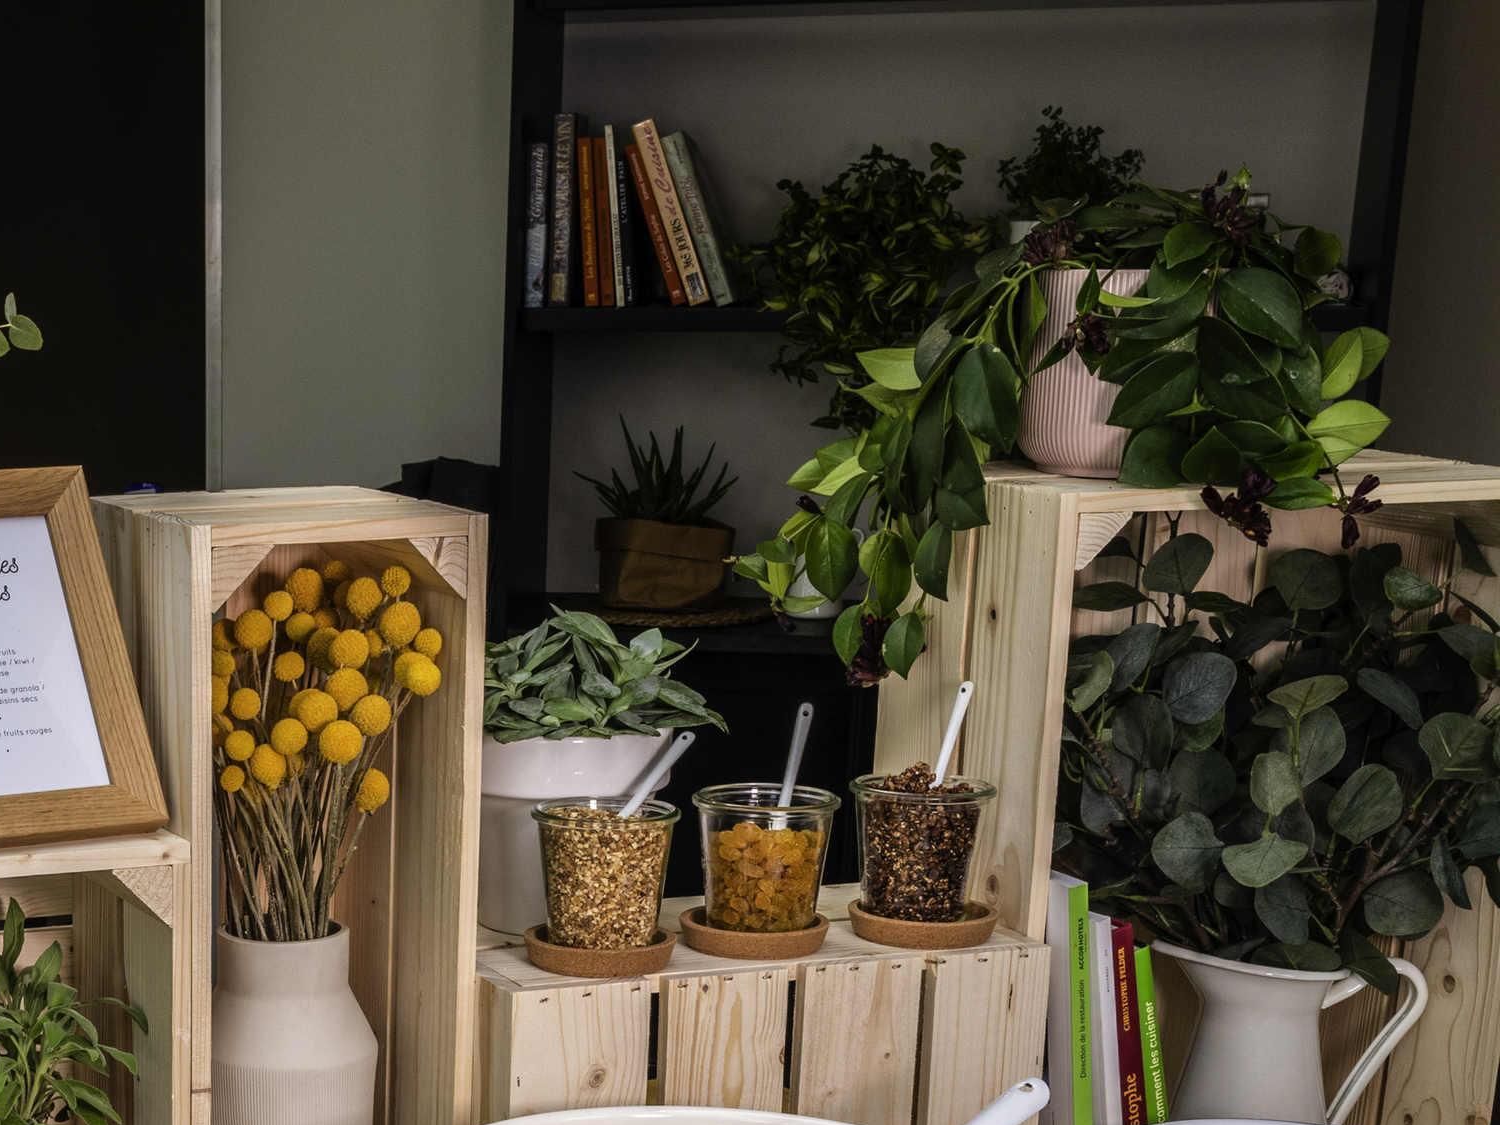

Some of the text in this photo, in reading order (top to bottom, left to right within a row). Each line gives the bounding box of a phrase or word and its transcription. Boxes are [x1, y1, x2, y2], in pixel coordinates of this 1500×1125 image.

[643, 125, 672, 193] Cuisine
[669, 217, 688, 253] JOURS
[14, 656, 30, 665] kiwi
[0, 686, 8, 694] de
[10, 684, 40, 694] granola
[3, 728, 24, 736] fruits
[26, 726, 52, 736] rouges
[1118, 947, 1131, 1032] CHRISTOPHE FELDER
[1079, 1034, 1086, 1043] de
[1079, 1046, 1087, 1078] Direction
[1146, 1001, 1165, 1123] comment les cuisiner
